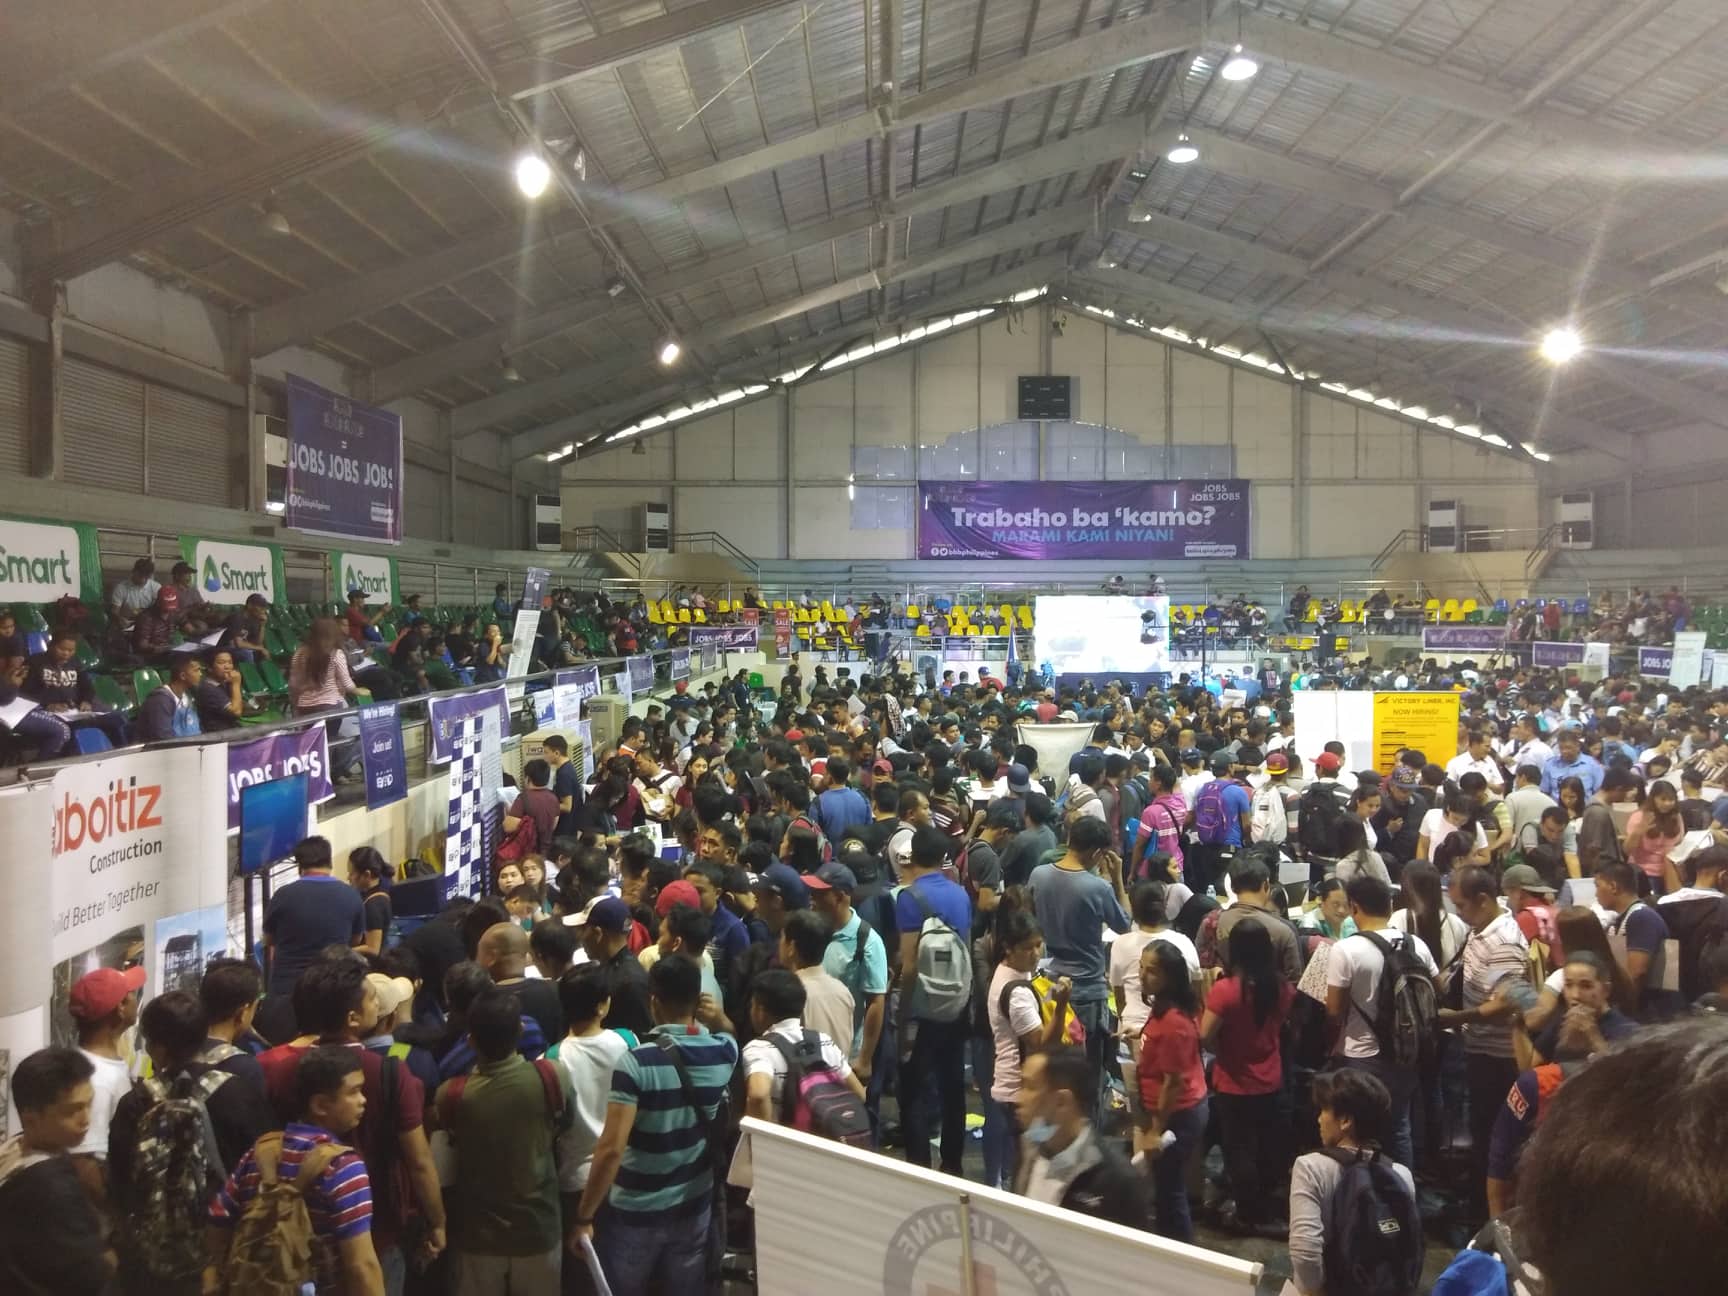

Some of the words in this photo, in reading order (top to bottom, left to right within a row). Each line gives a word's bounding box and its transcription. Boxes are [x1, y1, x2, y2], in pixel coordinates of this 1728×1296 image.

[291, 443, 325, 476] JOBS
[328, 453, 360, 484] JOBS
[1190, 493, 1214, 502] JOBS
[1216, 492, 1240, 501] JOBS
[1203, 484, 1227, 493] JOBS
[951, 507, 1067, 527] Trabaho
[1073, 507, 1109, 527] ba
[992, 530, 1061, 542] MARAMI
[1066, 530, 1109, 542] KAMI
[1115, 529, 1174, 542] NIYAN!
[221, 562, 268, 591] Smart
[357, 569, 388, 593] Smart
[89, 838, 162, 874] Construction
[72, 901, 105, 927] Better
[107, 880, 161, 912] Together
